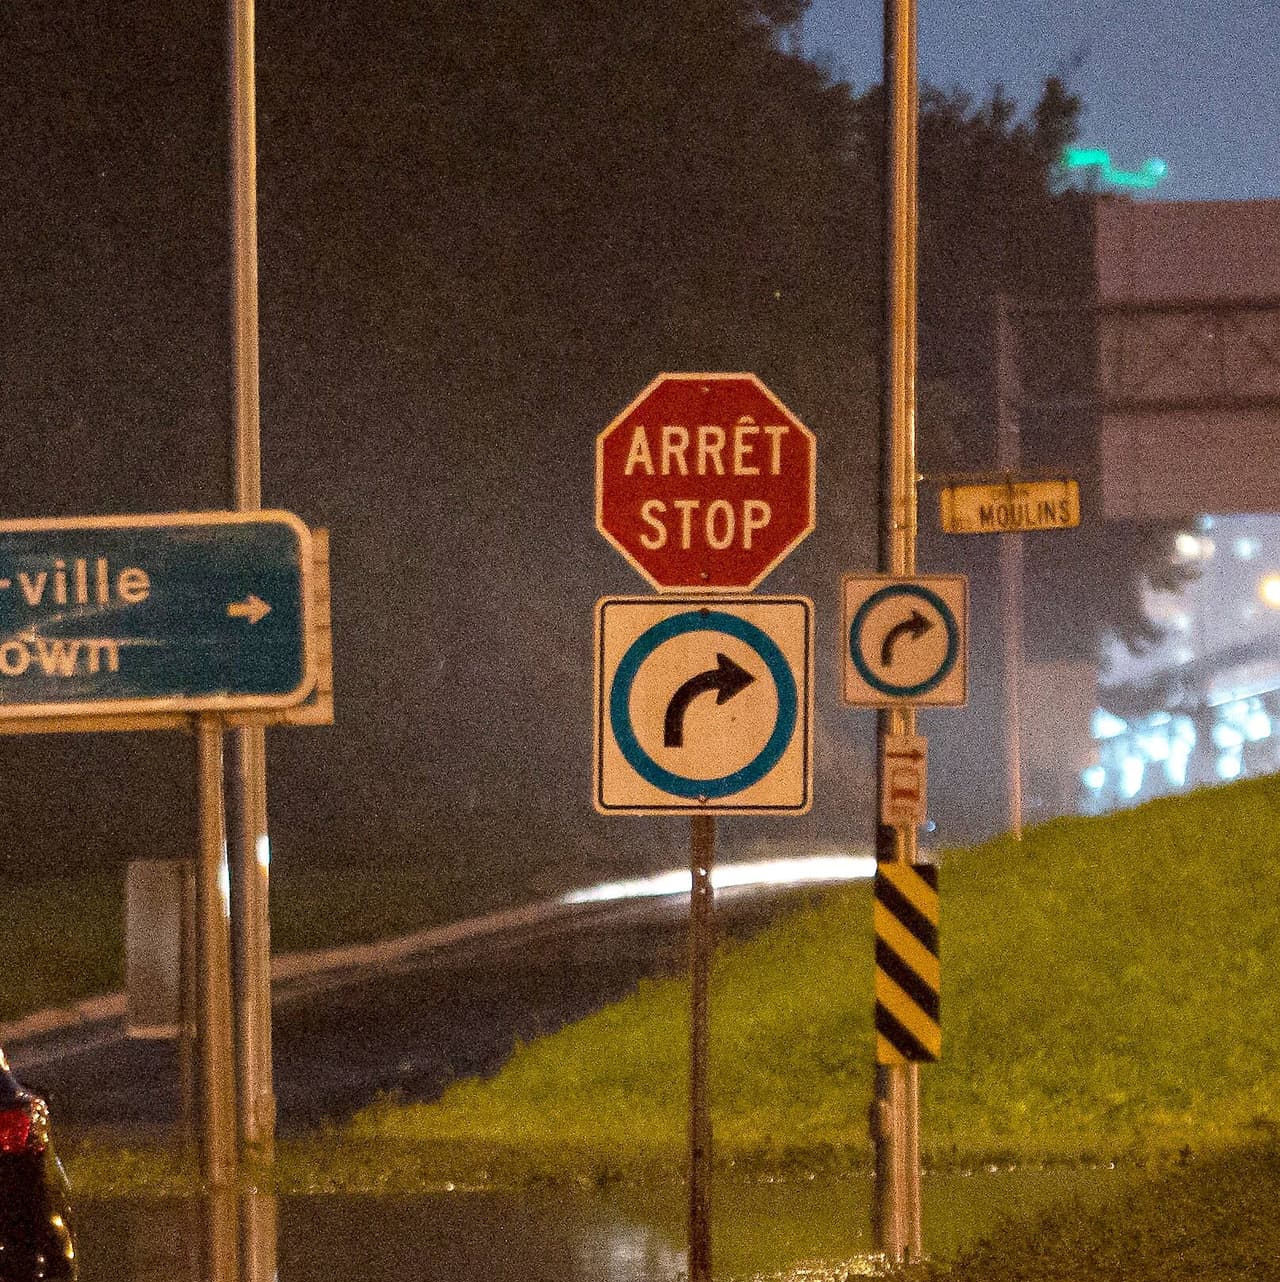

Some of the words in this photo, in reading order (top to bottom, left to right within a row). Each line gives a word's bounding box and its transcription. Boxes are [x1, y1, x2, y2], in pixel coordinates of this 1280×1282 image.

[624, 416, 789, 476] ARRÊT
[639, 498, 772, 551] STOP
[978, 499, 1071, 530] MOULINS
